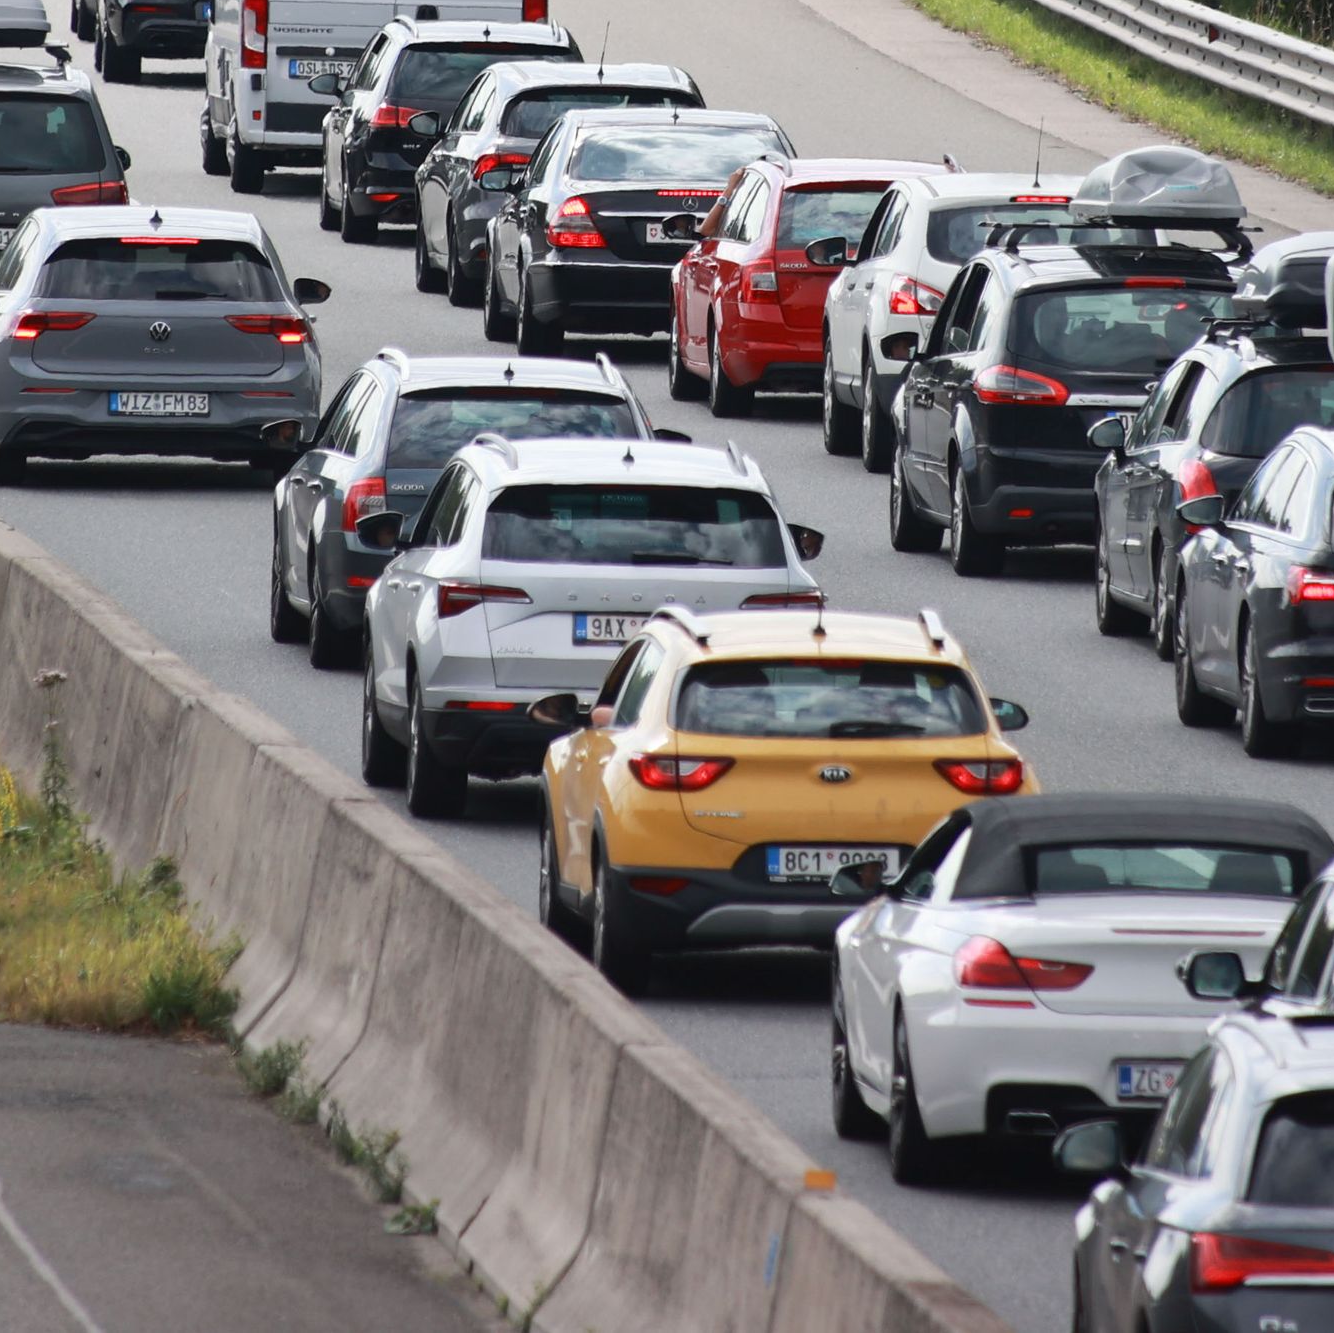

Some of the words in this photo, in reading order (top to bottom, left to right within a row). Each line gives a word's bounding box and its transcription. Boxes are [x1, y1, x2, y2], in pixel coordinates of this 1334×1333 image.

[298, 62, 319, 75] OSL
[120, 395, 152, 410] WIZ
[163, 395, 184, 411] FM
[188, 396, 207, 411] 83
[592, 618, 625, 637] 9AX
[823, 768, 846, 780] KIA
[785, 852, 821, 872] 8C1
[1136, 1068, 1160, 1093] ZG
